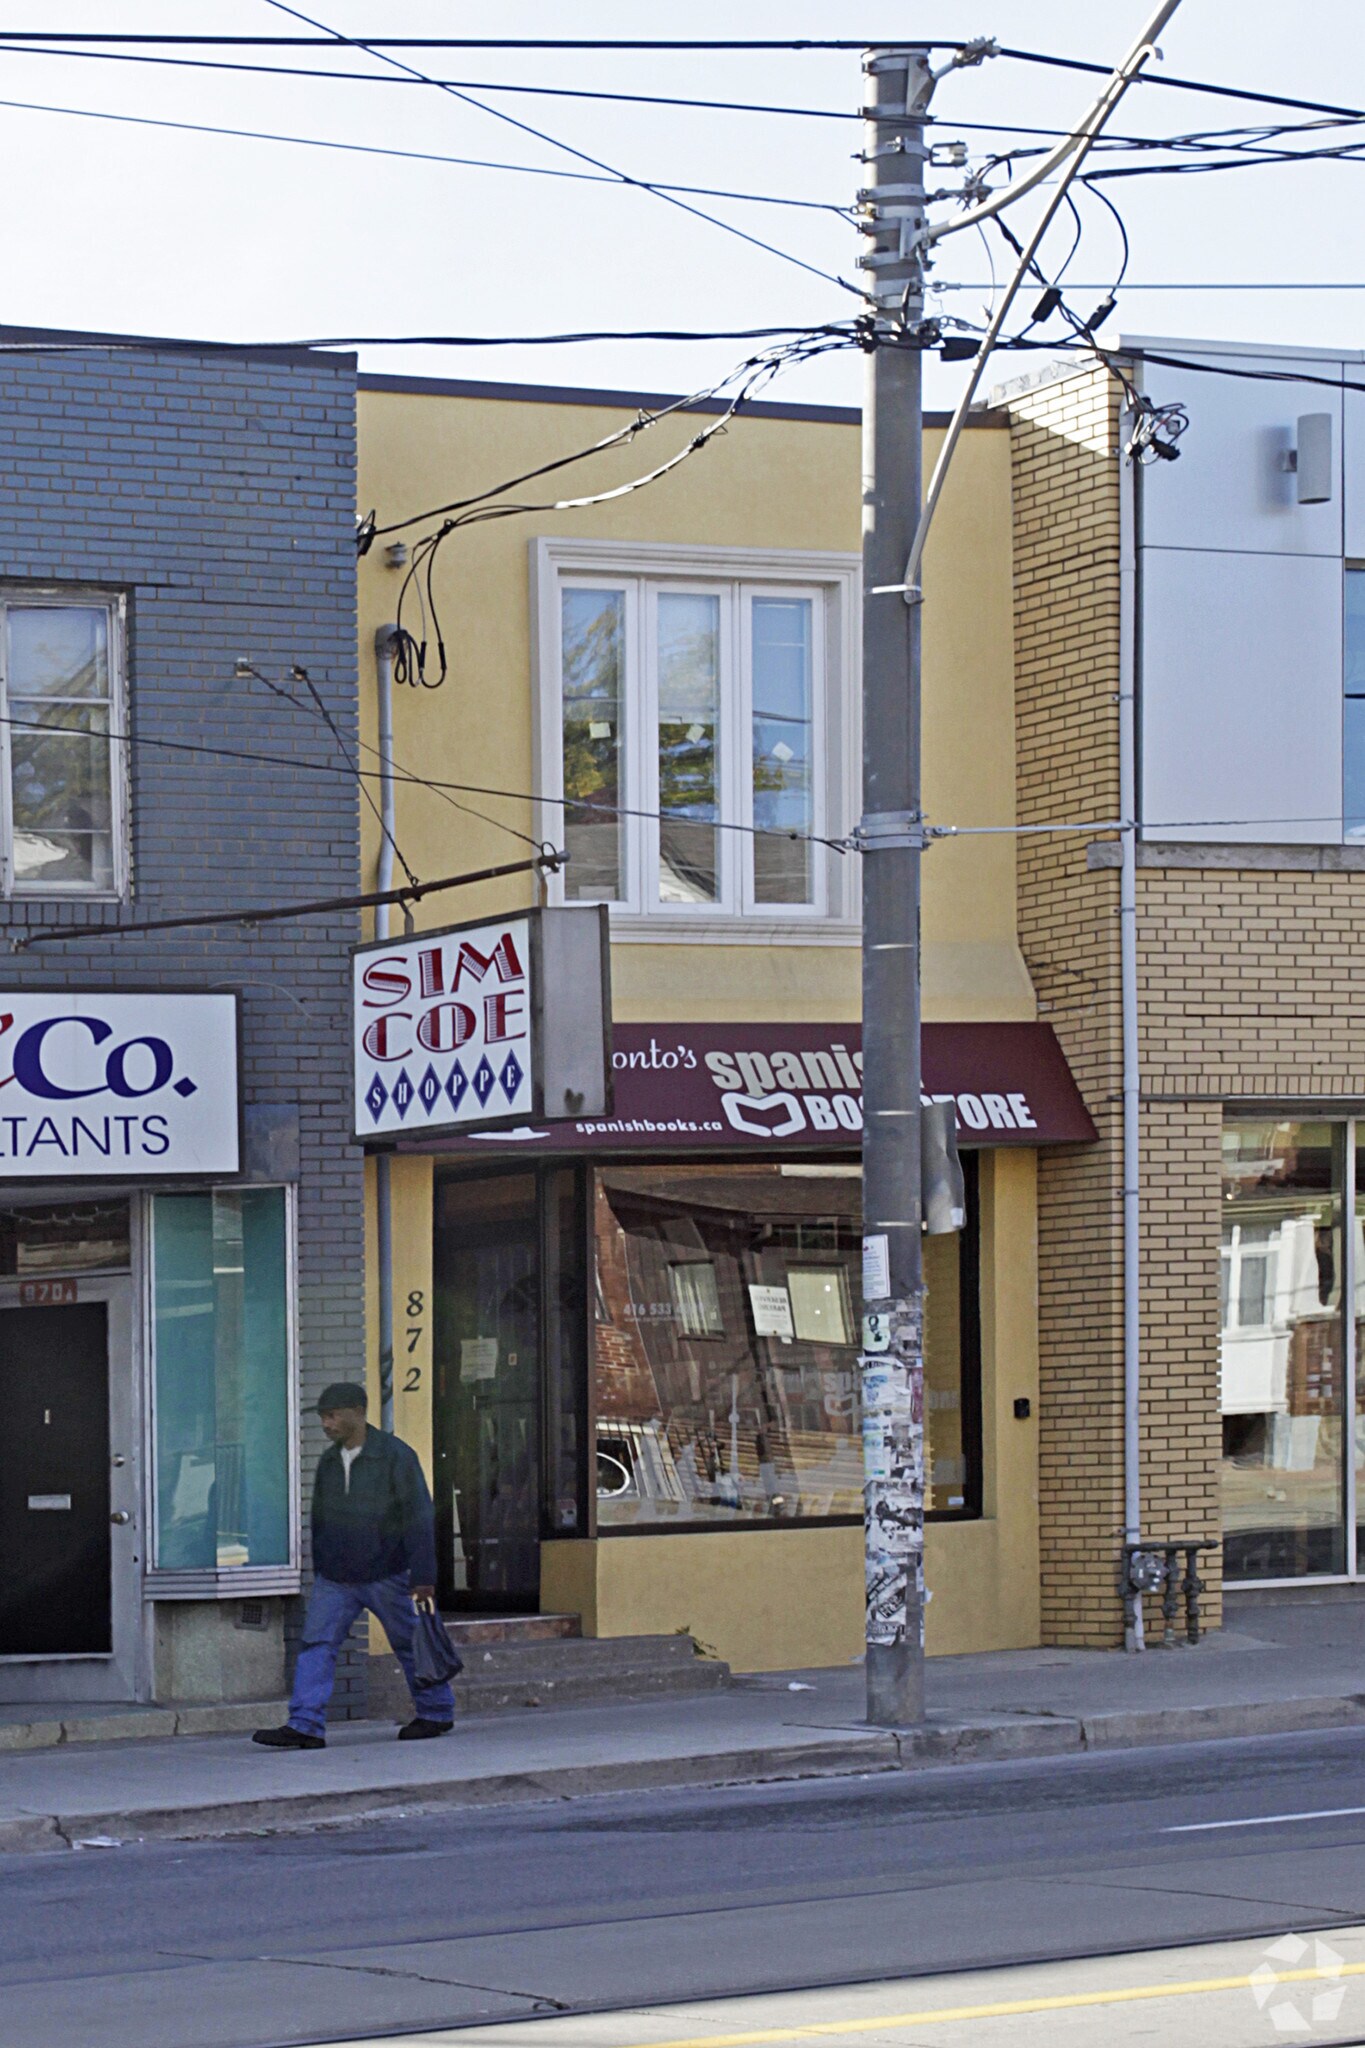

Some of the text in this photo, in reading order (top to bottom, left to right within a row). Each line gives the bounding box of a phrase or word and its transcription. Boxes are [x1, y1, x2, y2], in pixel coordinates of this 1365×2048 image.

[362, 932, 526, 1008] SIM
[362, 988, 527, 1062] COE
[612, 1038, 697, 1069] onto's
[704, 1044, 924, 1098] spani
[370, 1063, 517, 1110] SHOPPE
[0, 1115, 170, 1156] TANTS
[575, 1119, 723, 1135] spanishbooks.ca
[802, 1093, 1038, 1131] BOORE
[402, 1290, 424, 1392] 872
